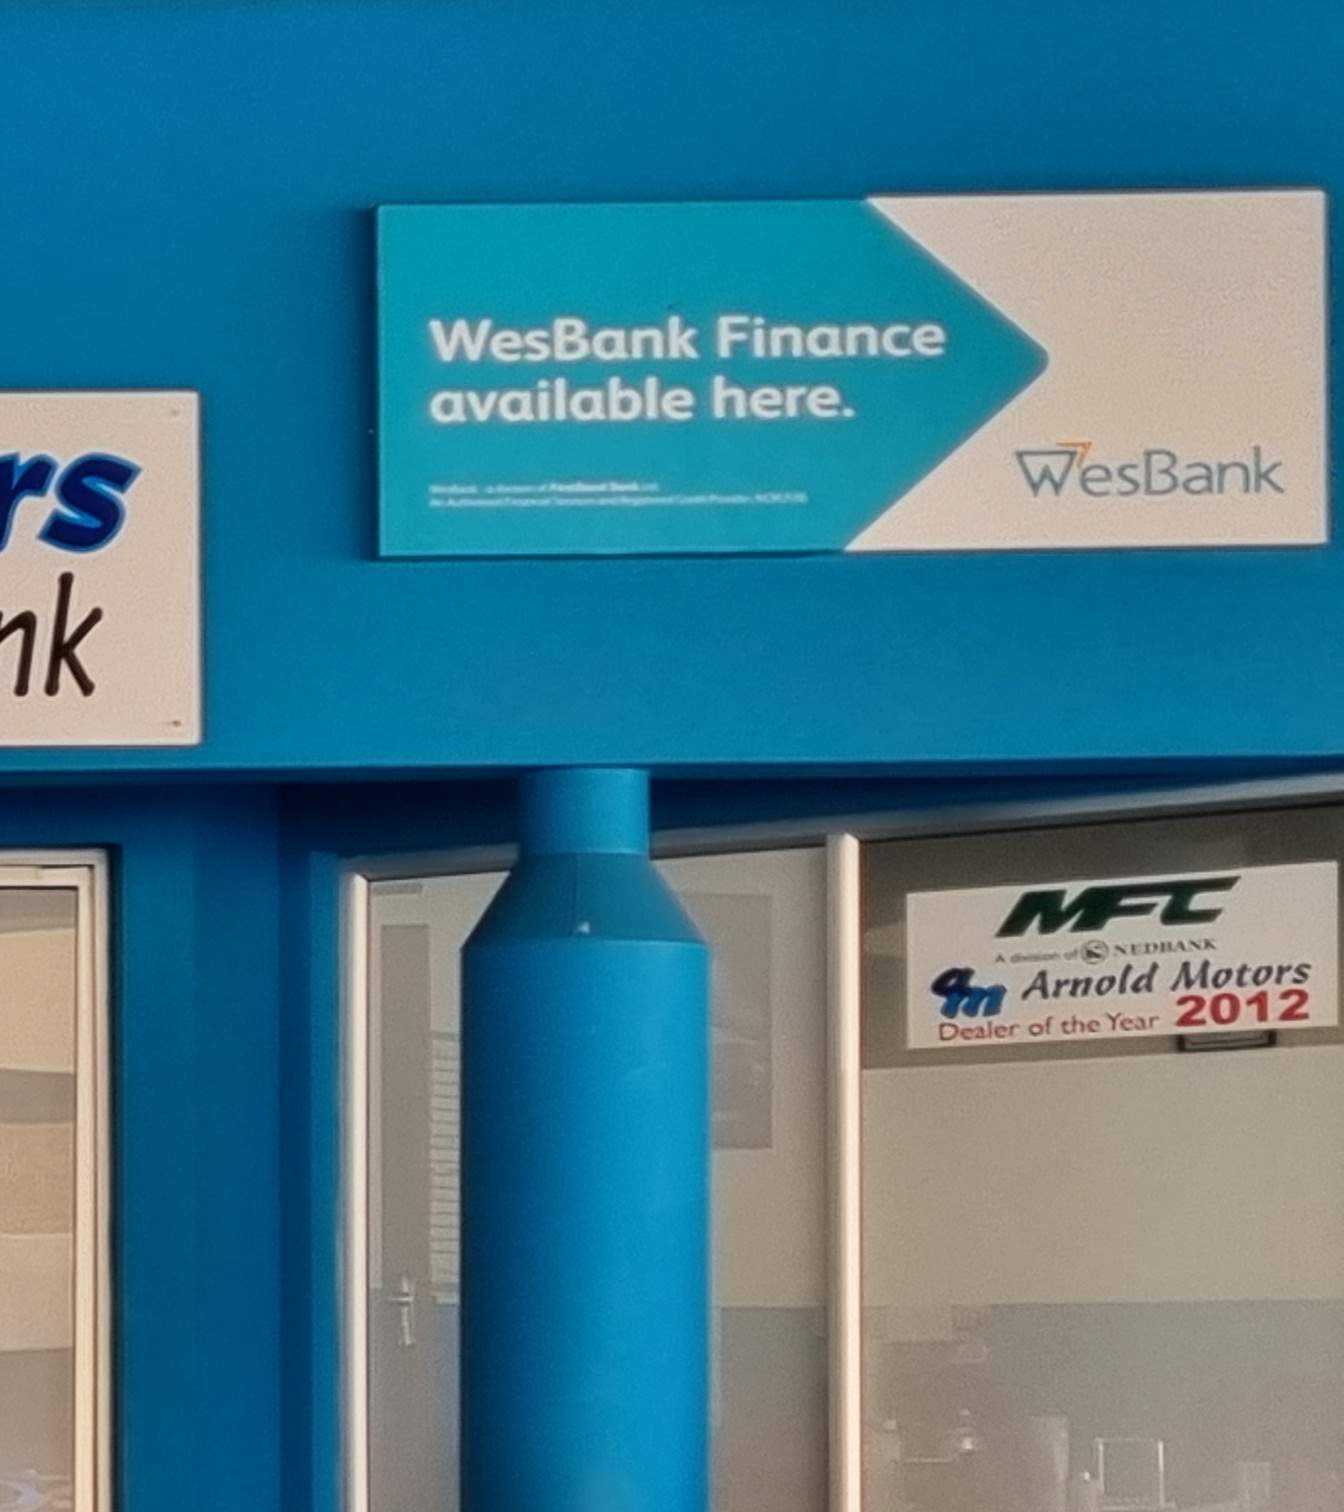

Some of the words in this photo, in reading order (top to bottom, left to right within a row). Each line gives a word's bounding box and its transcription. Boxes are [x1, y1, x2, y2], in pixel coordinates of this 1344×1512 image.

[429, 317, 698, 362] WesBank
[717, 315, 947, 360] Finance
[429, 377, 695, 424] available
[713, 374, 856, 420] here.
[1015, 444, 1285, 499] WesBank
[994, 876, 1241, 938] MFC
[1114, 938, 1216, 956] NEDBANK
[1021, 962, 1159, 1000] Arnold
[1170, 958, 1312, 991] Motors
[939, 1020, 1020, 1041] Dealer
[1028, 1015, 1054, 1036] of
[1061, 1014, 1100, 1034] the
[1106, 1012, 1160, 1031] Year
[1175, 988, 1310, 1027] 2012
